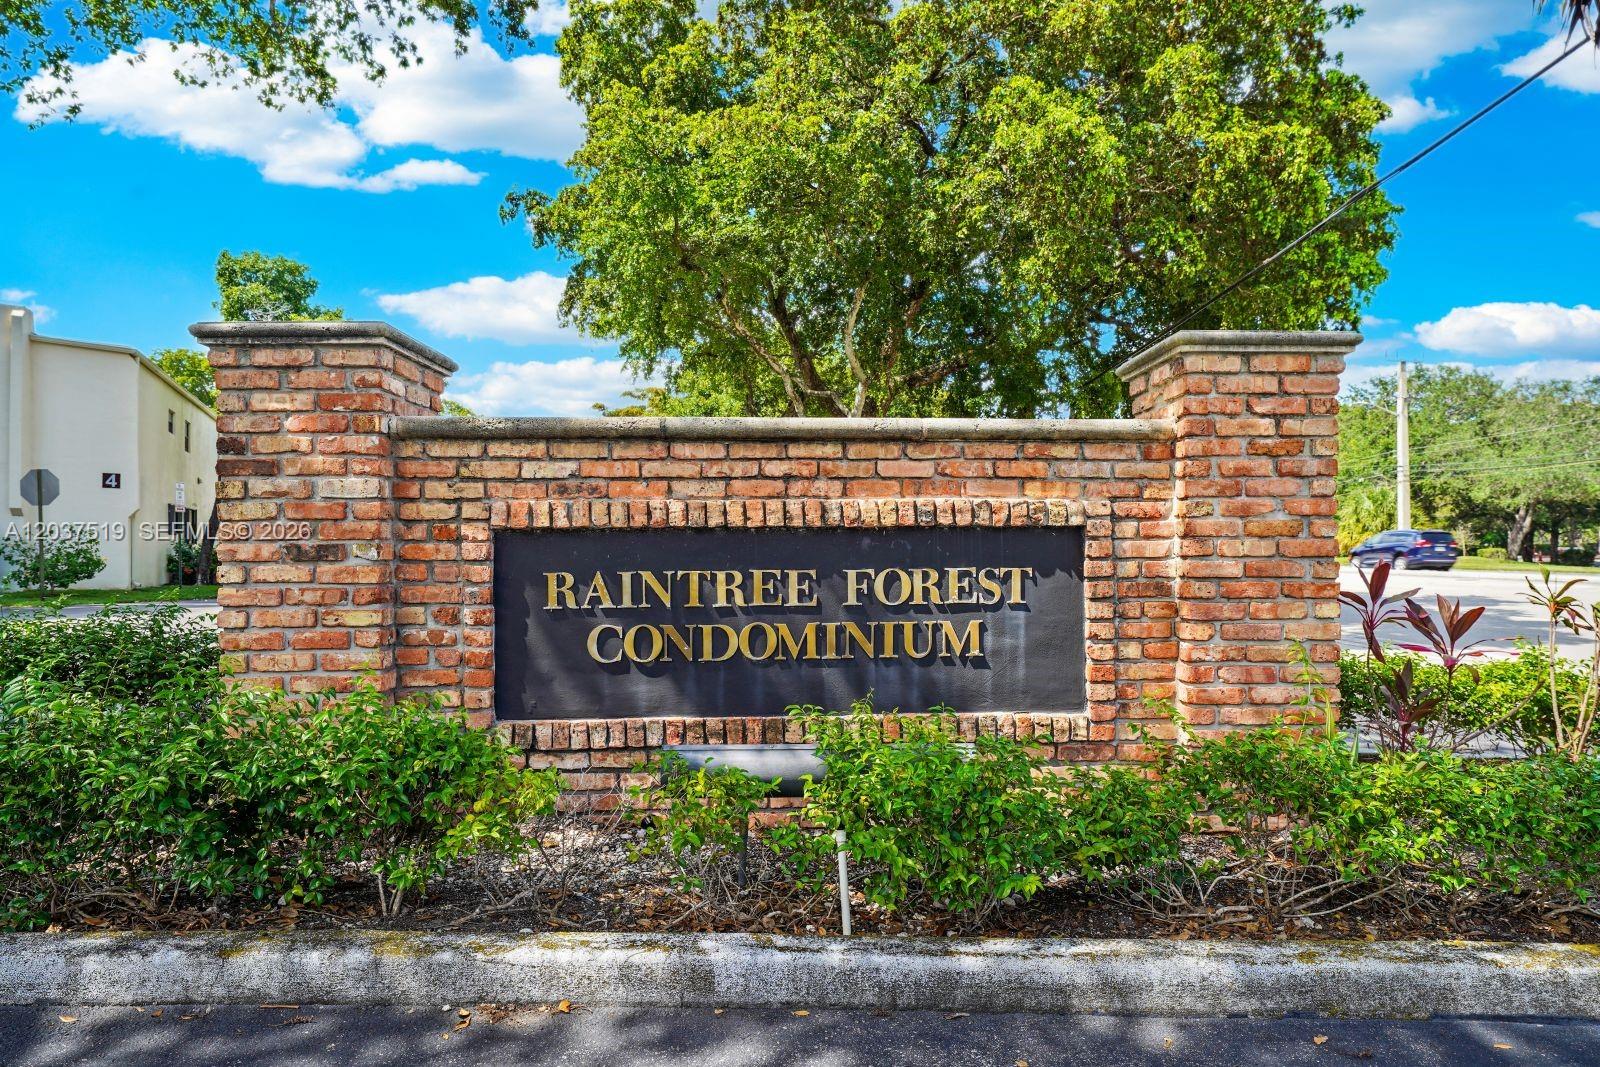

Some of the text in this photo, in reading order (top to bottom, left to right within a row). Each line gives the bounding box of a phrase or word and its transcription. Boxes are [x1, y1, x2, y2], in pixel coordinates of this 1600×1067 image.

[105, 474, 118, 488] 4
[543, 566, 1033, 610] RAINTREE FOREST
[586, 619, 984, 664] CONDOMINIUM
